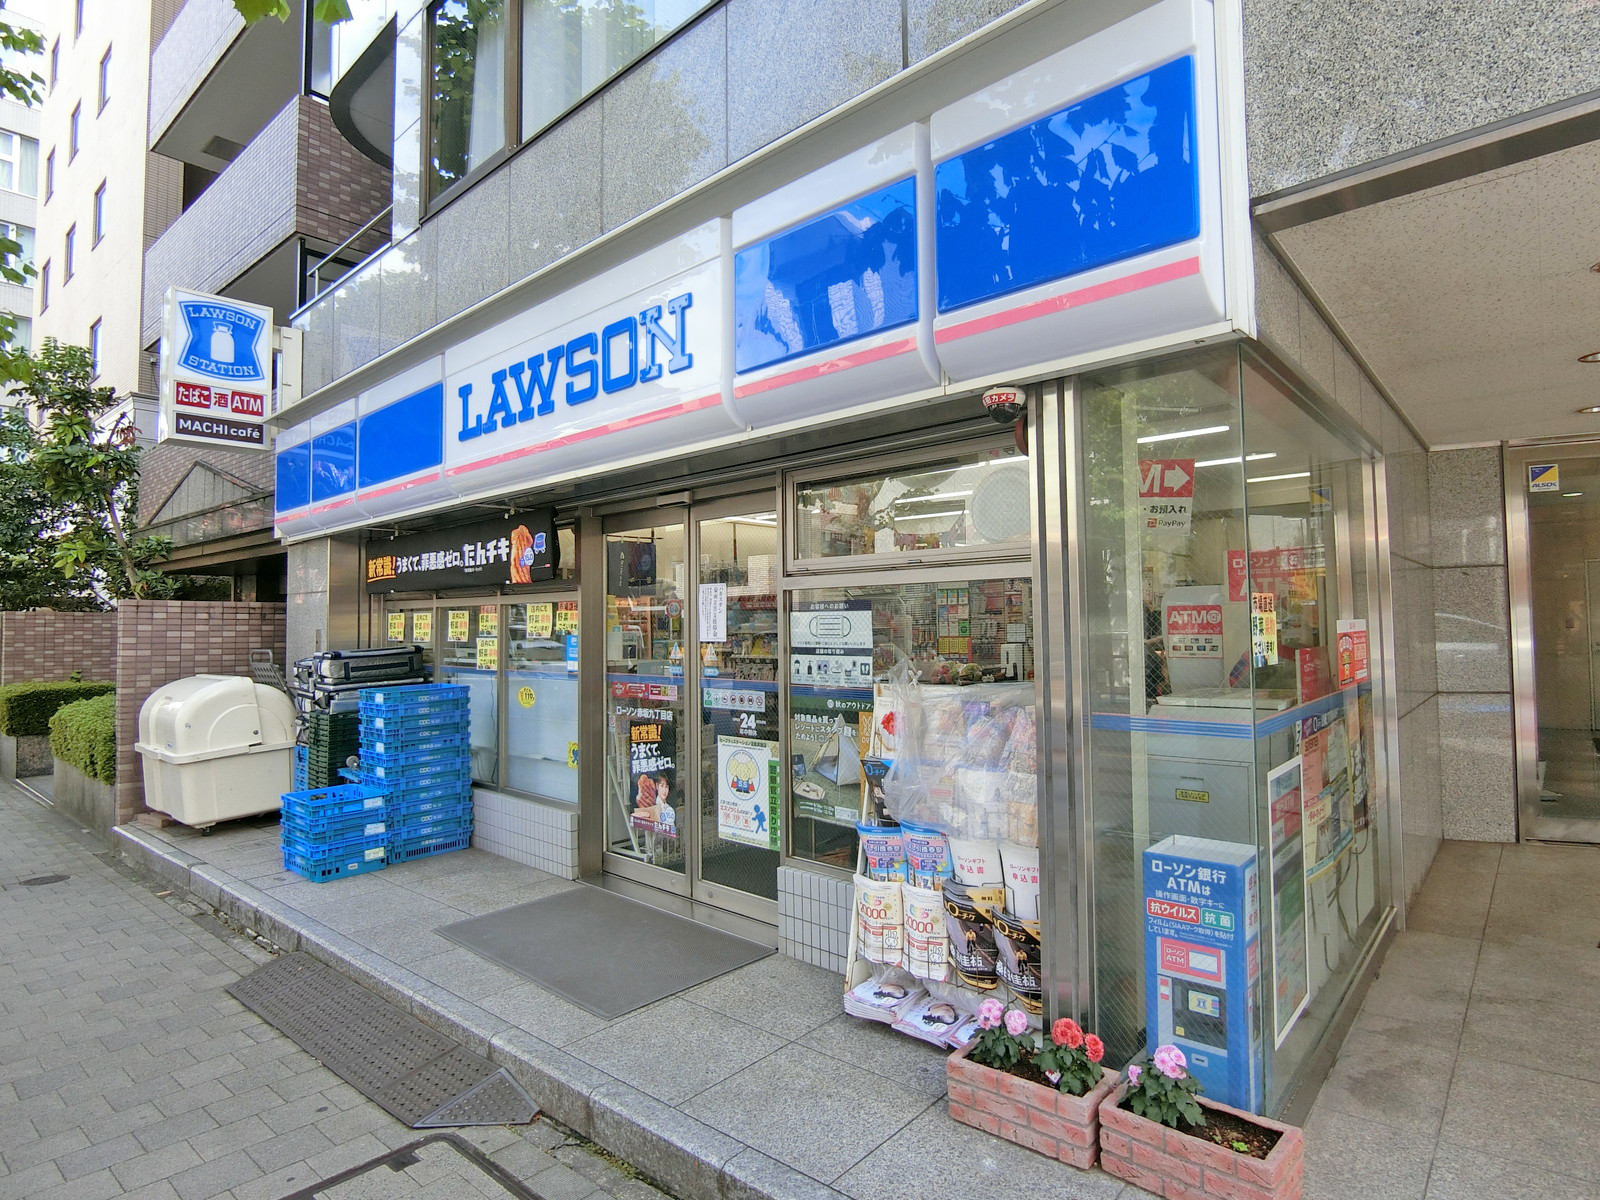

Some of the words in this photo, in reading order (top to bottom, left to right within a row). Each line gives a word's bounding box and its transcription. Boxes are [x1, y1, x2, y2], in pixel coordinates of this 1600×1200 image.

[188, 306, 257, 330] LAWSON
[188, 355, 256, 376] STATION
[458, 292, 693, 442] LAWSON
[178, 386, 211, 405] たばこ
[213, 392, 228, 407] 酒
[232, 397, 262, 412] ATM
[984, 393, 1015, 404] 犯カメラ
[179, 418, 228, 435] MACHI
[230, 426, 261, 439] café
[1159, 520, 1186, 528] PayPay
[463, 537, 510, 567] たんチキ
[1169, 611, 1207, 624] ATM
[616, 706, 673, 721] ローソン赤坂九丁目店
[740, 712, 756, 729] 24
[630, 724, 661, 740] 新常識!
[631, 743, 660, 759] うまくて、
[632, 756, 675, 773] 罪悪感ゼロ。
[960, 864, 984, 874] 申込書
[1151, 859, 1227, 884] ローソン銀行
[1012, 873, 1038, 883] 申込書
[1167, 877, 1211, 896] ATMは
[1155, 889, 1225, 909] 操作画面・数字キーに
[1150, 901, 1197, 920] 抗ウイルス
[1204, 911, 1231, 928] 抗菌
[1148, 925, 1178, 938] しています。
[1166, 947, 1185, 956] ローソン
[1166, 954, 1185, 964] ATM
